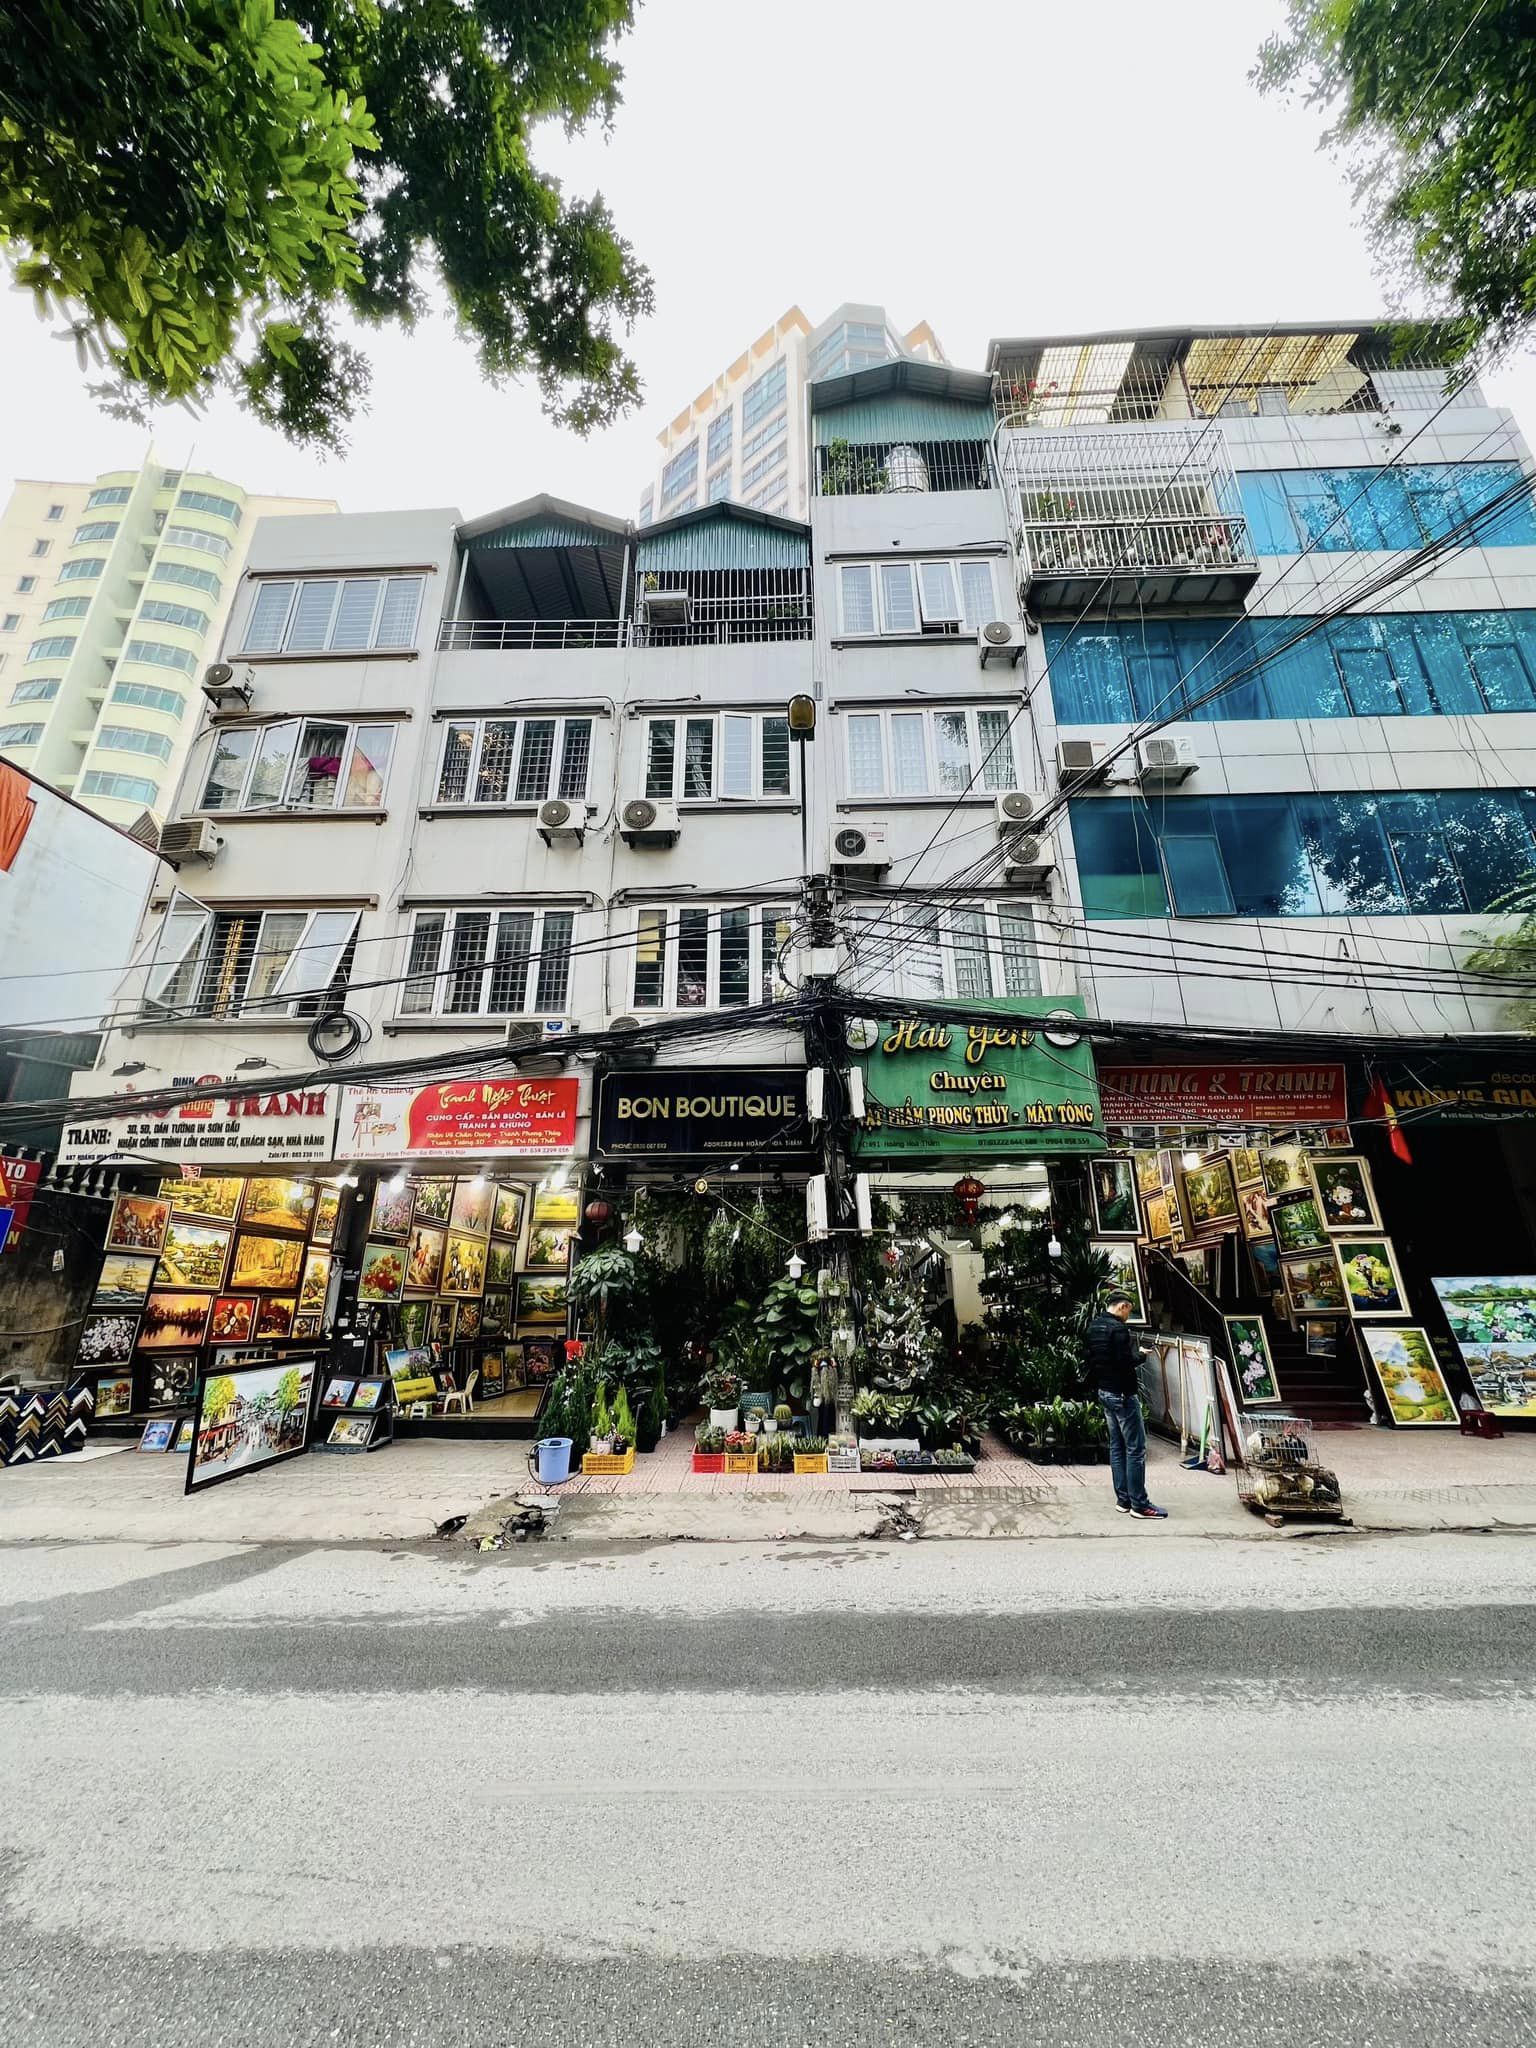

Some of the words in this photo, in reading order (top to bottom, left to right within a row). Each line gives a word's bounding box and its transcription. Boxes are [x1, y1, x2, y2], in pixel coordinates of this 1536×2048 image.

[930, 1071, 1007, 1094] Chuyên
[1100, 1072, 1199, 1094] KHUNG
[1208, 1073, 1229, 1094] &
[1239, 1071, 1337, 1092] TRANH
[225, 1092, 328, 1117] TRANH
[437, 1085, 476, 1109] Tranh
[617, 1097, 669, 1119] BON
[675, 1095, 796, 1118] BOUTIQUE
[482, 1111, 501, 1120] BÁN
[502, 1111, 529, 1120] BUÔN
[535, 1110, 554, 1119] BÁN
[928, 1105, 972, 1124] PHONG
[974, 1098, 1010, 1124] THỦY
[1057, 1098, 1094, 1124] TÔNG
[207, 1122, 223, 1133] SƠN
[499, 1121, 532, 1129] KHUNG
[67, 1129, 112, 1145] TRANH:
[199, 1136, 225, 1147] CHUNG
[240, 1134, 265, 1146] KHÁCH
[286, 1134, 301, 1146] NHÀ
[303, 1133, 325, 1146] HÀNG
